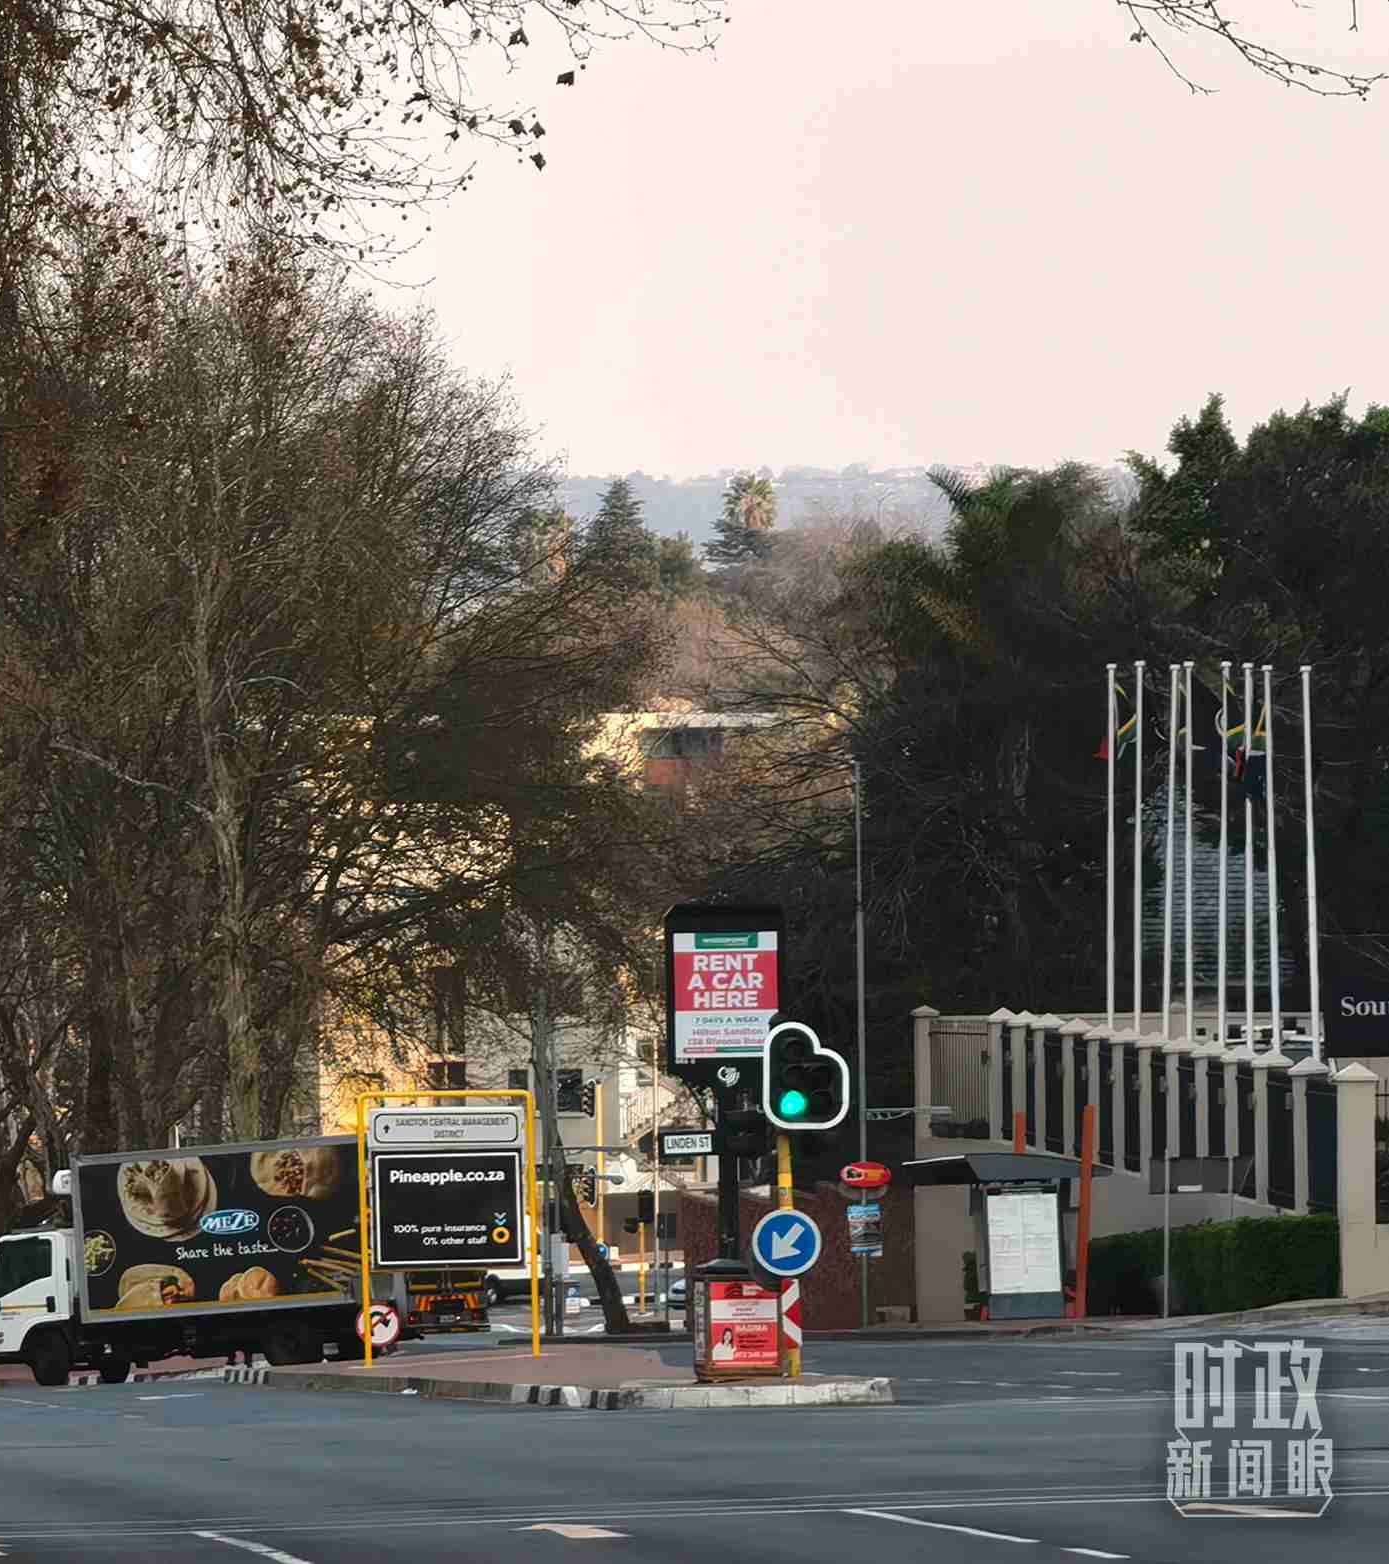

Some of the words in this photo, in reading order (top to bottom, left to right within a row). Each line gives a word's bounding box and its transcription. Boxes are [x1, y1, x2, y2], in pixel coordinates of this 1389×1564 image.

[693, 954, 758, 971] RENT
[687, 973, 706, 990] A
[712, 972, 764, 990] CAR
[693, 990, 758, 1008] HERE
[1341, 996, 1389, 1017] Sou
[667, 1137, 697, 1149] LINDEN
[390, 1169, 506, 1185] Pineapple.co.za
[393, 1224, 419, 1233] 100%
[444, 1224, 487, 1232] insurance
[422, 1237, 438, 1245] 0%
[440, 1237, 465, 1245] other
[176, 1246, 209, 1260] Share
[213, 1243, 233, 1256] the
